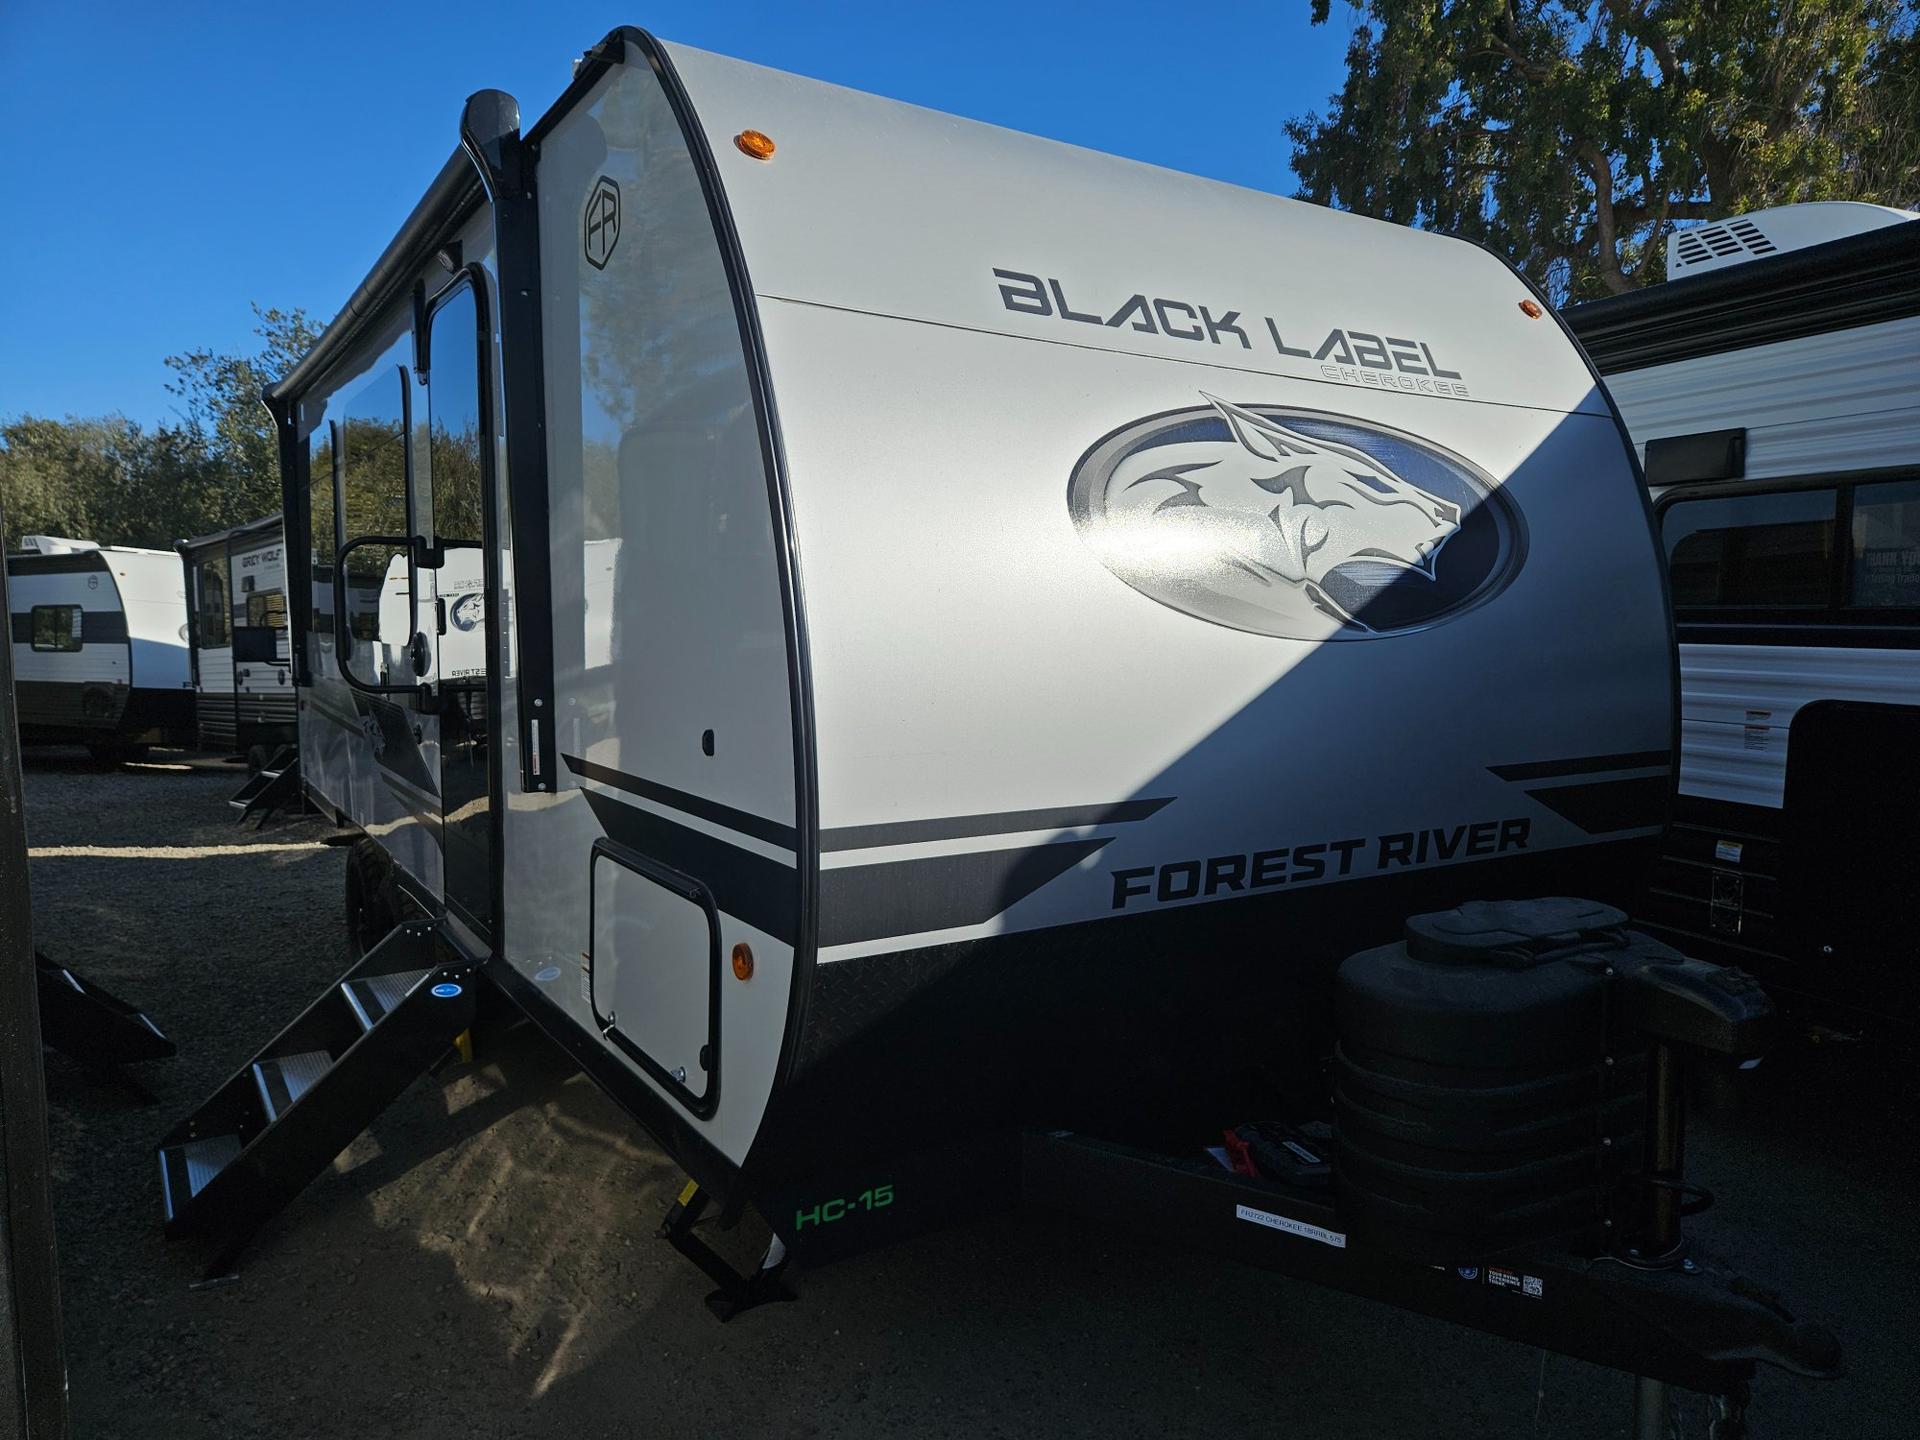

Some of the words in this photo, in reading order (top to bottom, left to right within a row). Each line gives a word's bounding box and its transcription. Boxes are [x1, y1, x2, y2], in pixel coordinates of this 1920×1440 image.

[992, 267, 1251, 349] BLACK
[1265, 317, 1461, 380] LABEL
[1320, 364, 1470, 397] CHEROKEE
[242, 554, 259, 568] GREY
[261, 549, 282, 562] WOLF
[1111, 838, 1365, 909] FOREST
[1378, 818, 1531, 869] RIVER
[795, 1184, 895, 1231] HC-15
[1265, 1215, 1303, 1231] CHEROKEE
